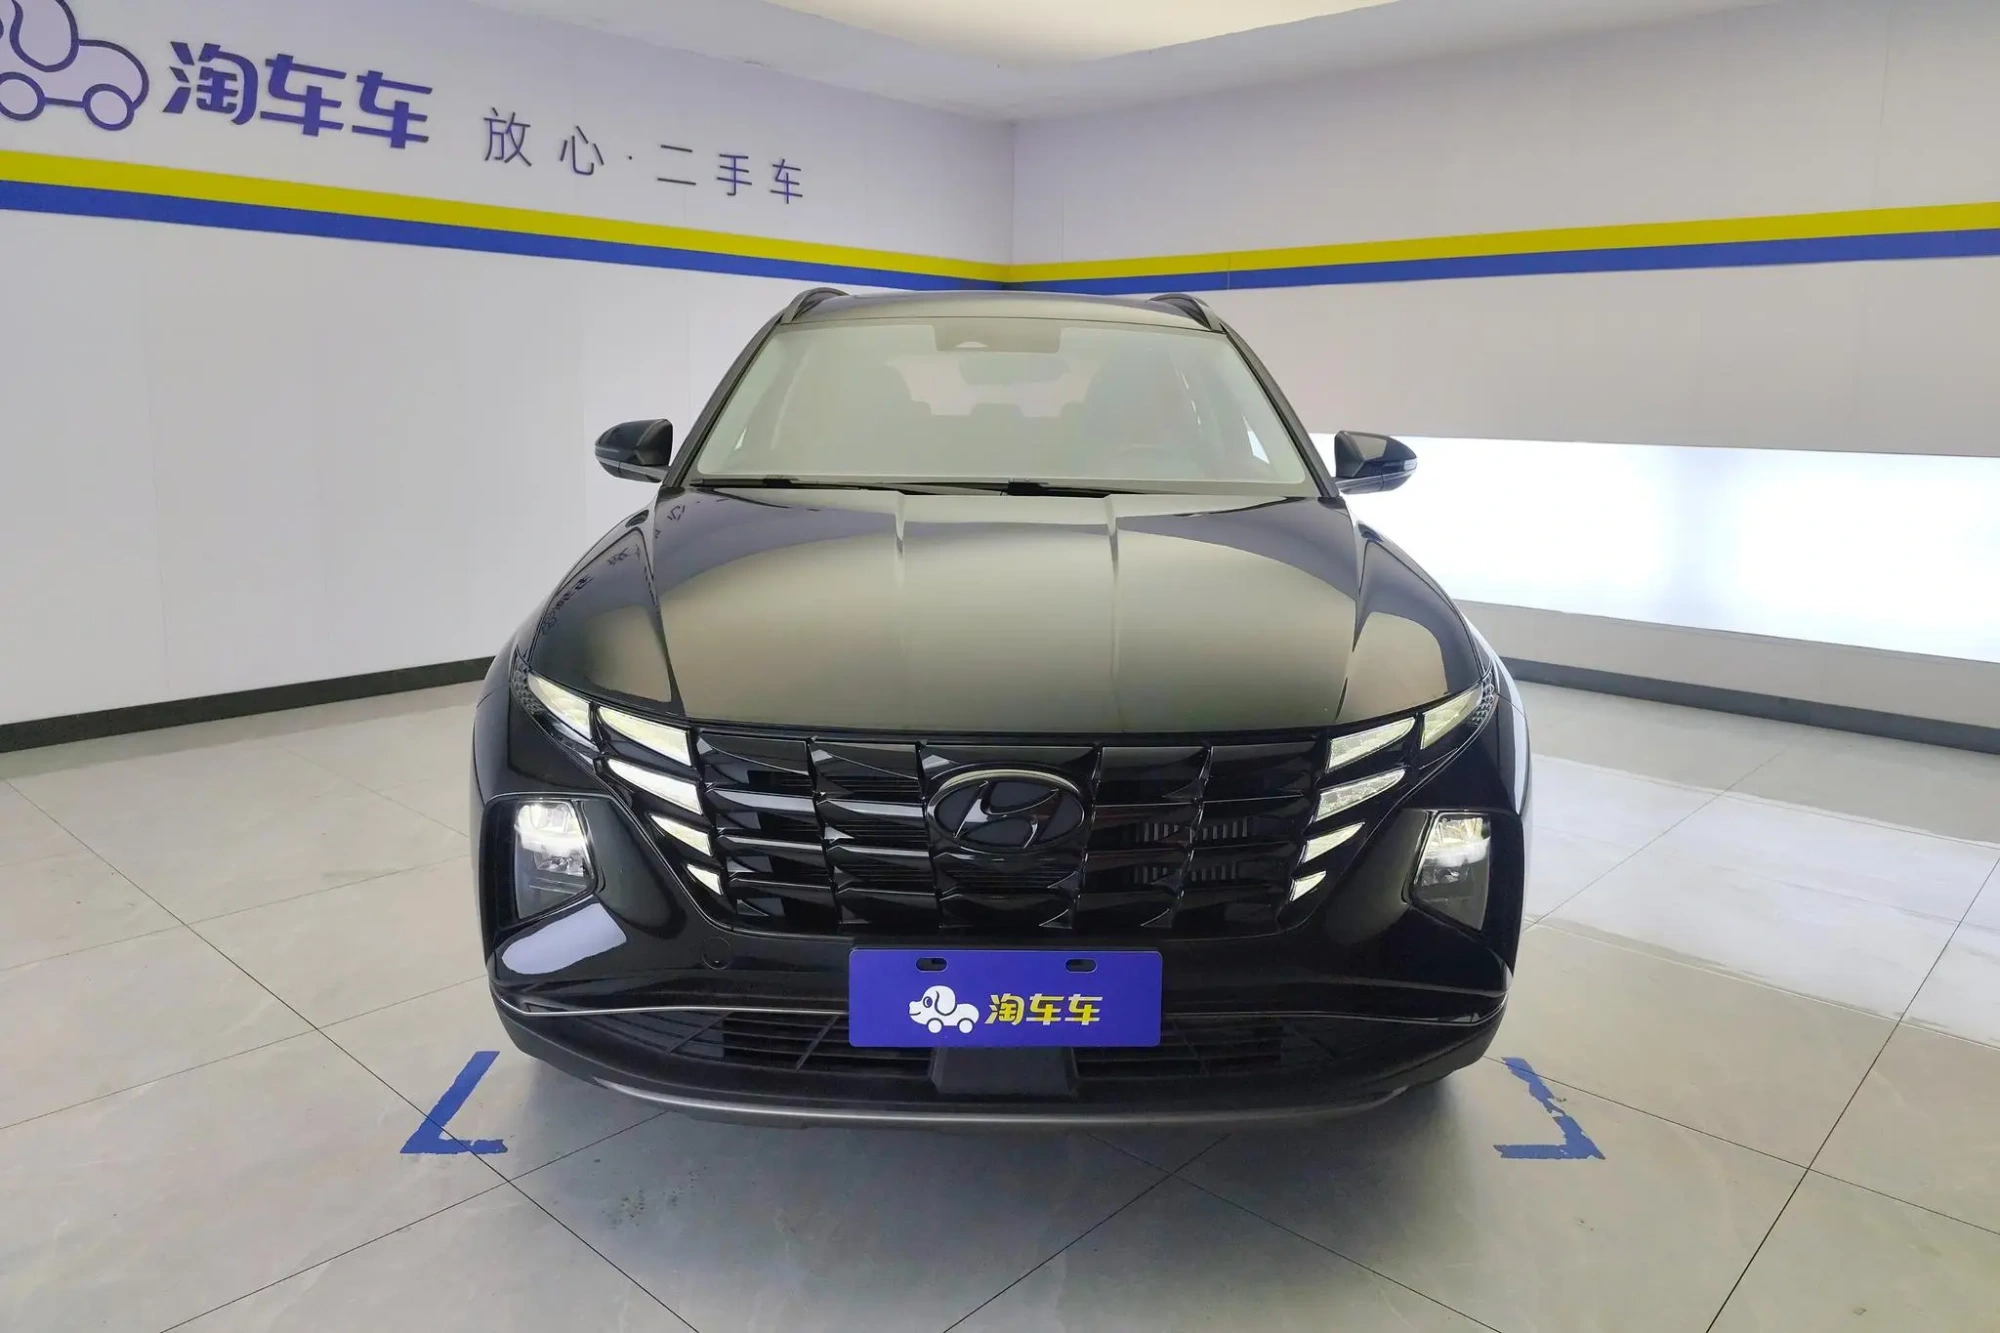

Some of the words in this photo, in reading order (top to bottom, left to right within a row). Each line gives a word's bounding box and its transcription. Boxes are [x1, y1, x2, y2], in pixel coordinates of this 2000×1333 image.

[163, 41, 434, 150] 淘车车
[985, 993, 1103, 1026] 淘车车
